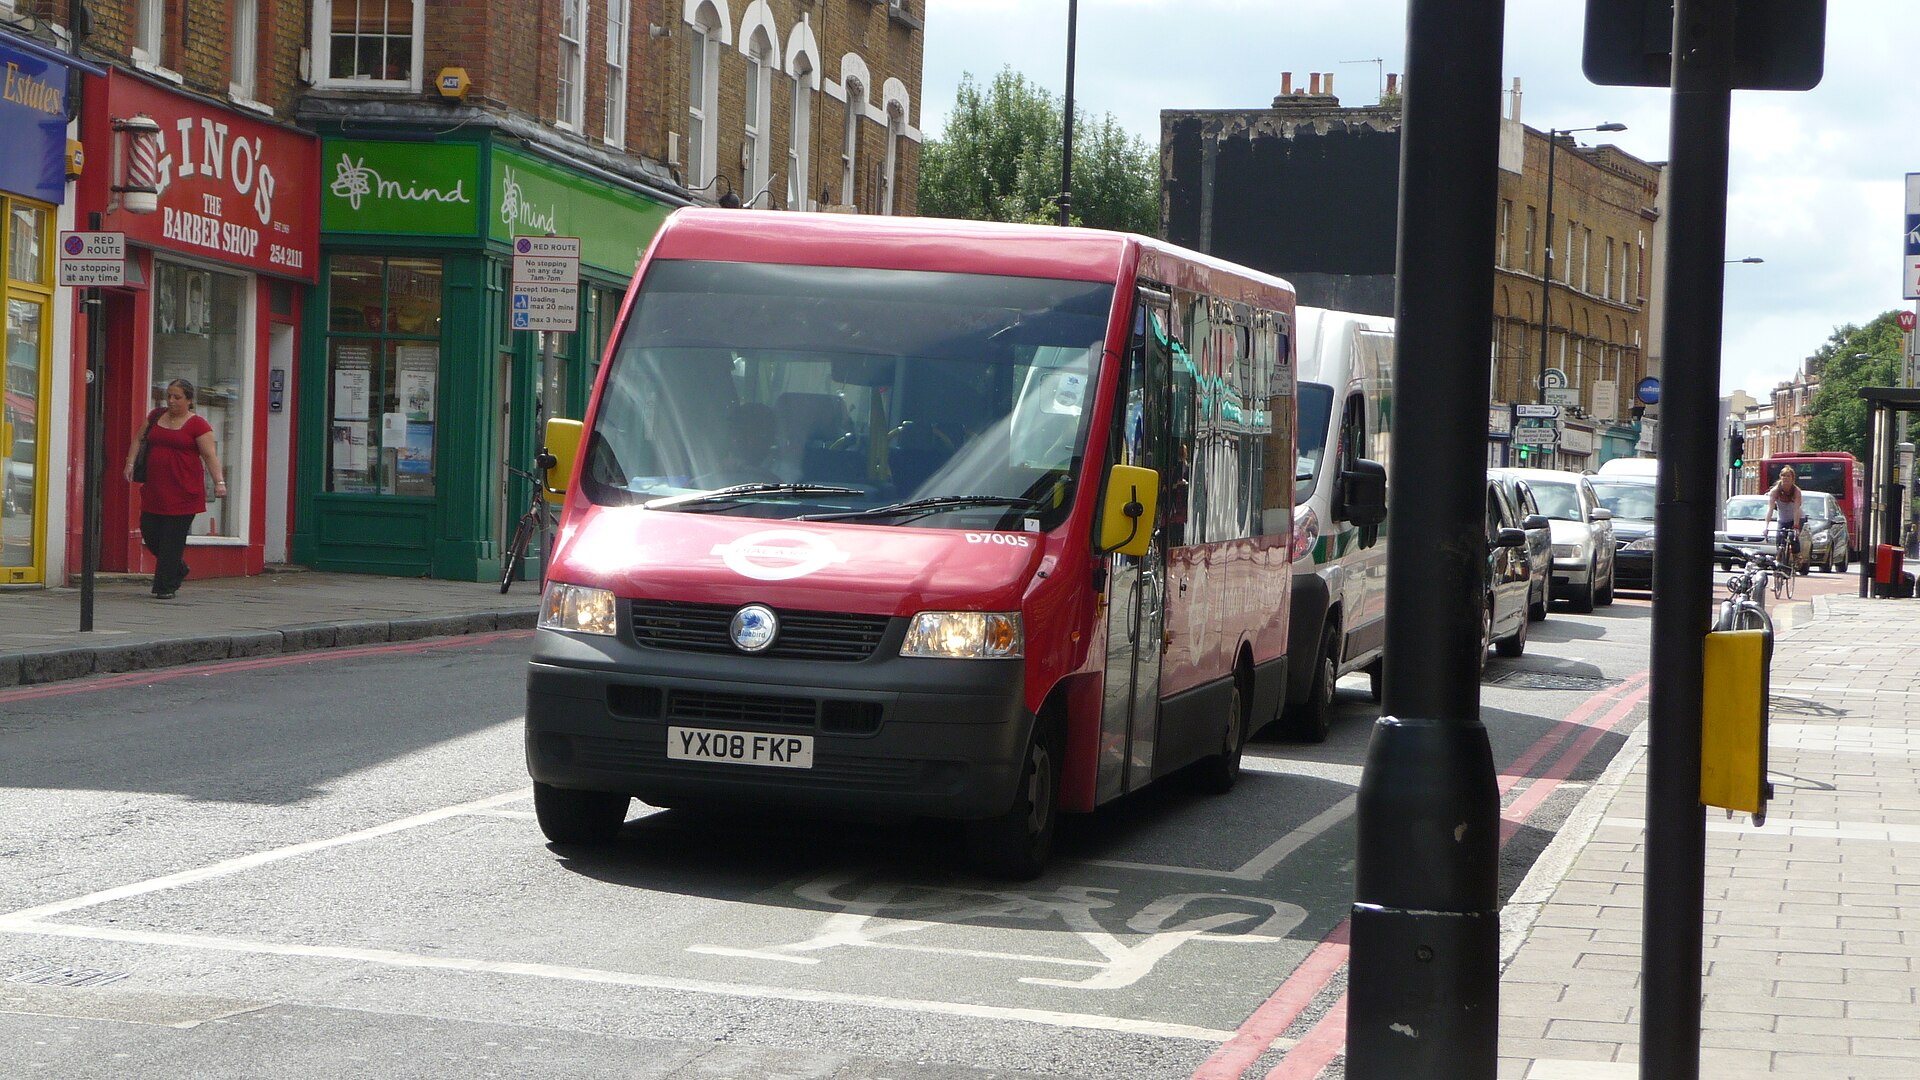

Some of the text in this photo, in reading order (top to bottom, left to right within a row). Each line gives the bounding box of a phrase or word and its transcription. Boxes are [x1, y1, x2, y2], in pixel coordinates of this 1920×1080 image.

[3, 62, 60, 115] Estates
[378, 179, 470, 203] mind
[203, 193, 222, 216] THE
[520, 200, 556, 234] mind
[163, 206, 258, 258] BARBER SHOP
[270, 244, 302, 268] 254 2111
[81, 264, 120, 273] stopping
[1900, 316, 1914, 325] W
[964, 533, 1028, 547] D7005
[737, 630, 766, 638] Bluebird
[680, 731, 802, 762] YX08 FKP
